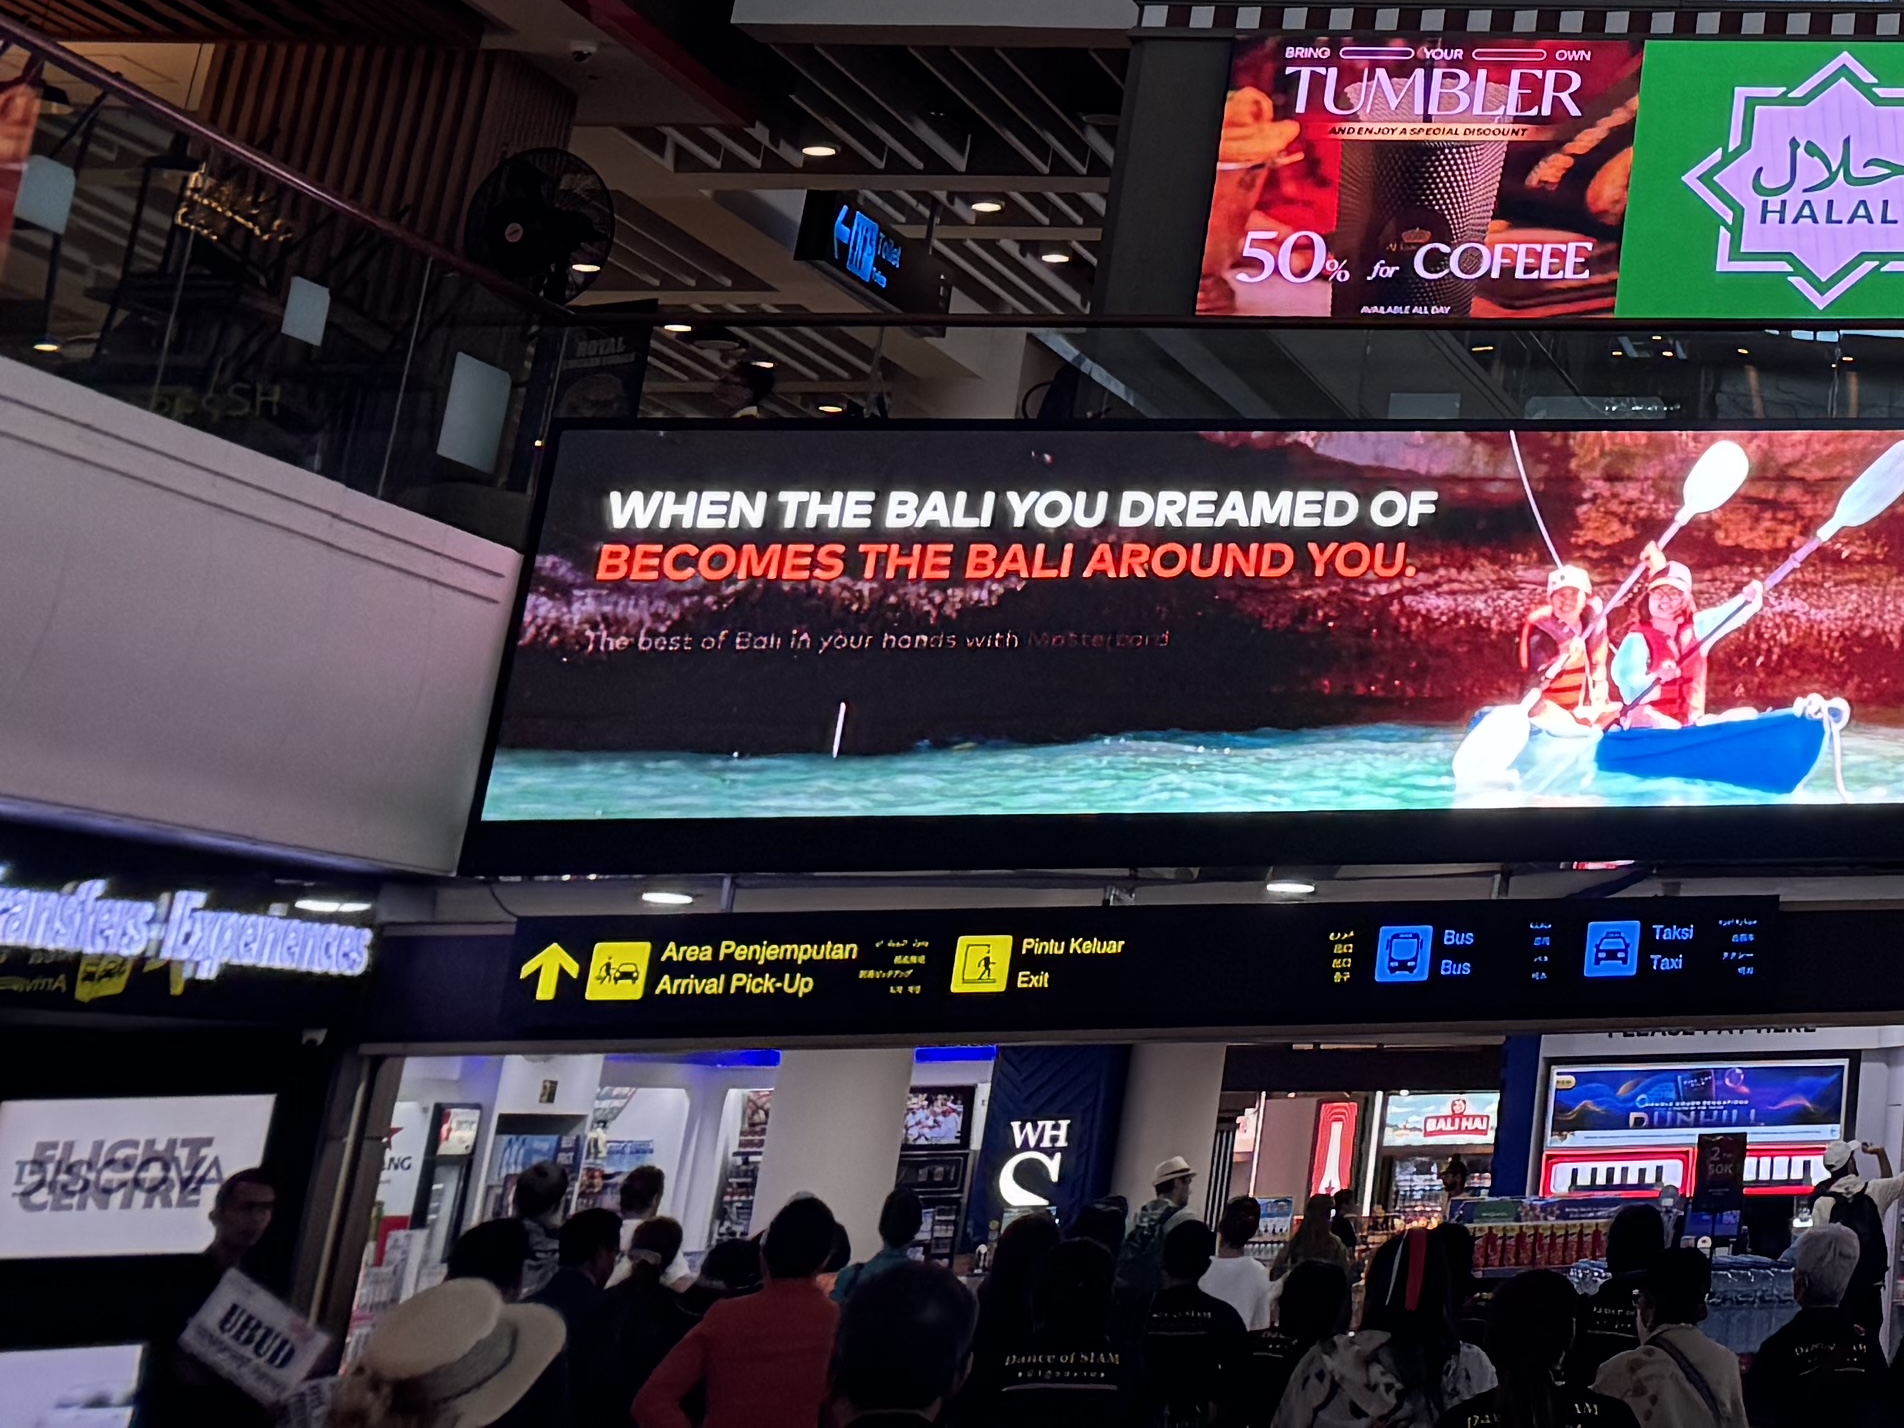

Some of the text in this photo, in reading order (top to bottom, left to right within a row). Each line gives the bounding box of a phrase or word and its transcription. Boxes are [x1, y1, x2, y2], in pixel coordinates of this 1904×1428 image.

[1284, 46, 1592, 62] BRING YOUR OWN
[1284, 65, 1584, 118] TUMBLER
[1328, 126, 1357, 137] AND
[1357, 126, 1399, 137] ENJOY
[1759, 198, 1899, 225] HALAL
[1234, 229, 1400, 284] 50% for
[1411, 305, 1429, 316] ALL
[1430, 306, 1452, 316] DAY
[608, 489, 1440, 529] WHEN THE BALI YOU DREAMED OF
[594, 541, 1418, 582] BECOMES THE BALI AROUND YOU.
[584, 629, 630, 651] The
[637, 630, 694, 652] best
[700, 629, 729, 651] of
[734, 629, 782, 651] Bali
[789, 628, 812, 651] in
[817, 632, 874, 655] your
[882, 630, 958, 650] hands
[965, 630, 1020, 650] with
[159, 889, 374, 981] Experiences
[1443, 929, 1475, 946] Bus
[1652, 924, 1694, 941] Taksi
[660, 940, 858, 965] Area Penjemputan
[1021, 937, 1126, 955] Pintu Keluar
[1440, 959, 1471, 976] Bus
[1650, 954, 1683, 971] Taxi
[655, 972, 814, 998] Arrival Pick-Up
[1016, 971, 1050, 989] Exit
[1010, 1119, 1072, 1149] WH
[1425, 1116, 1488, 1132] BALI HAI
